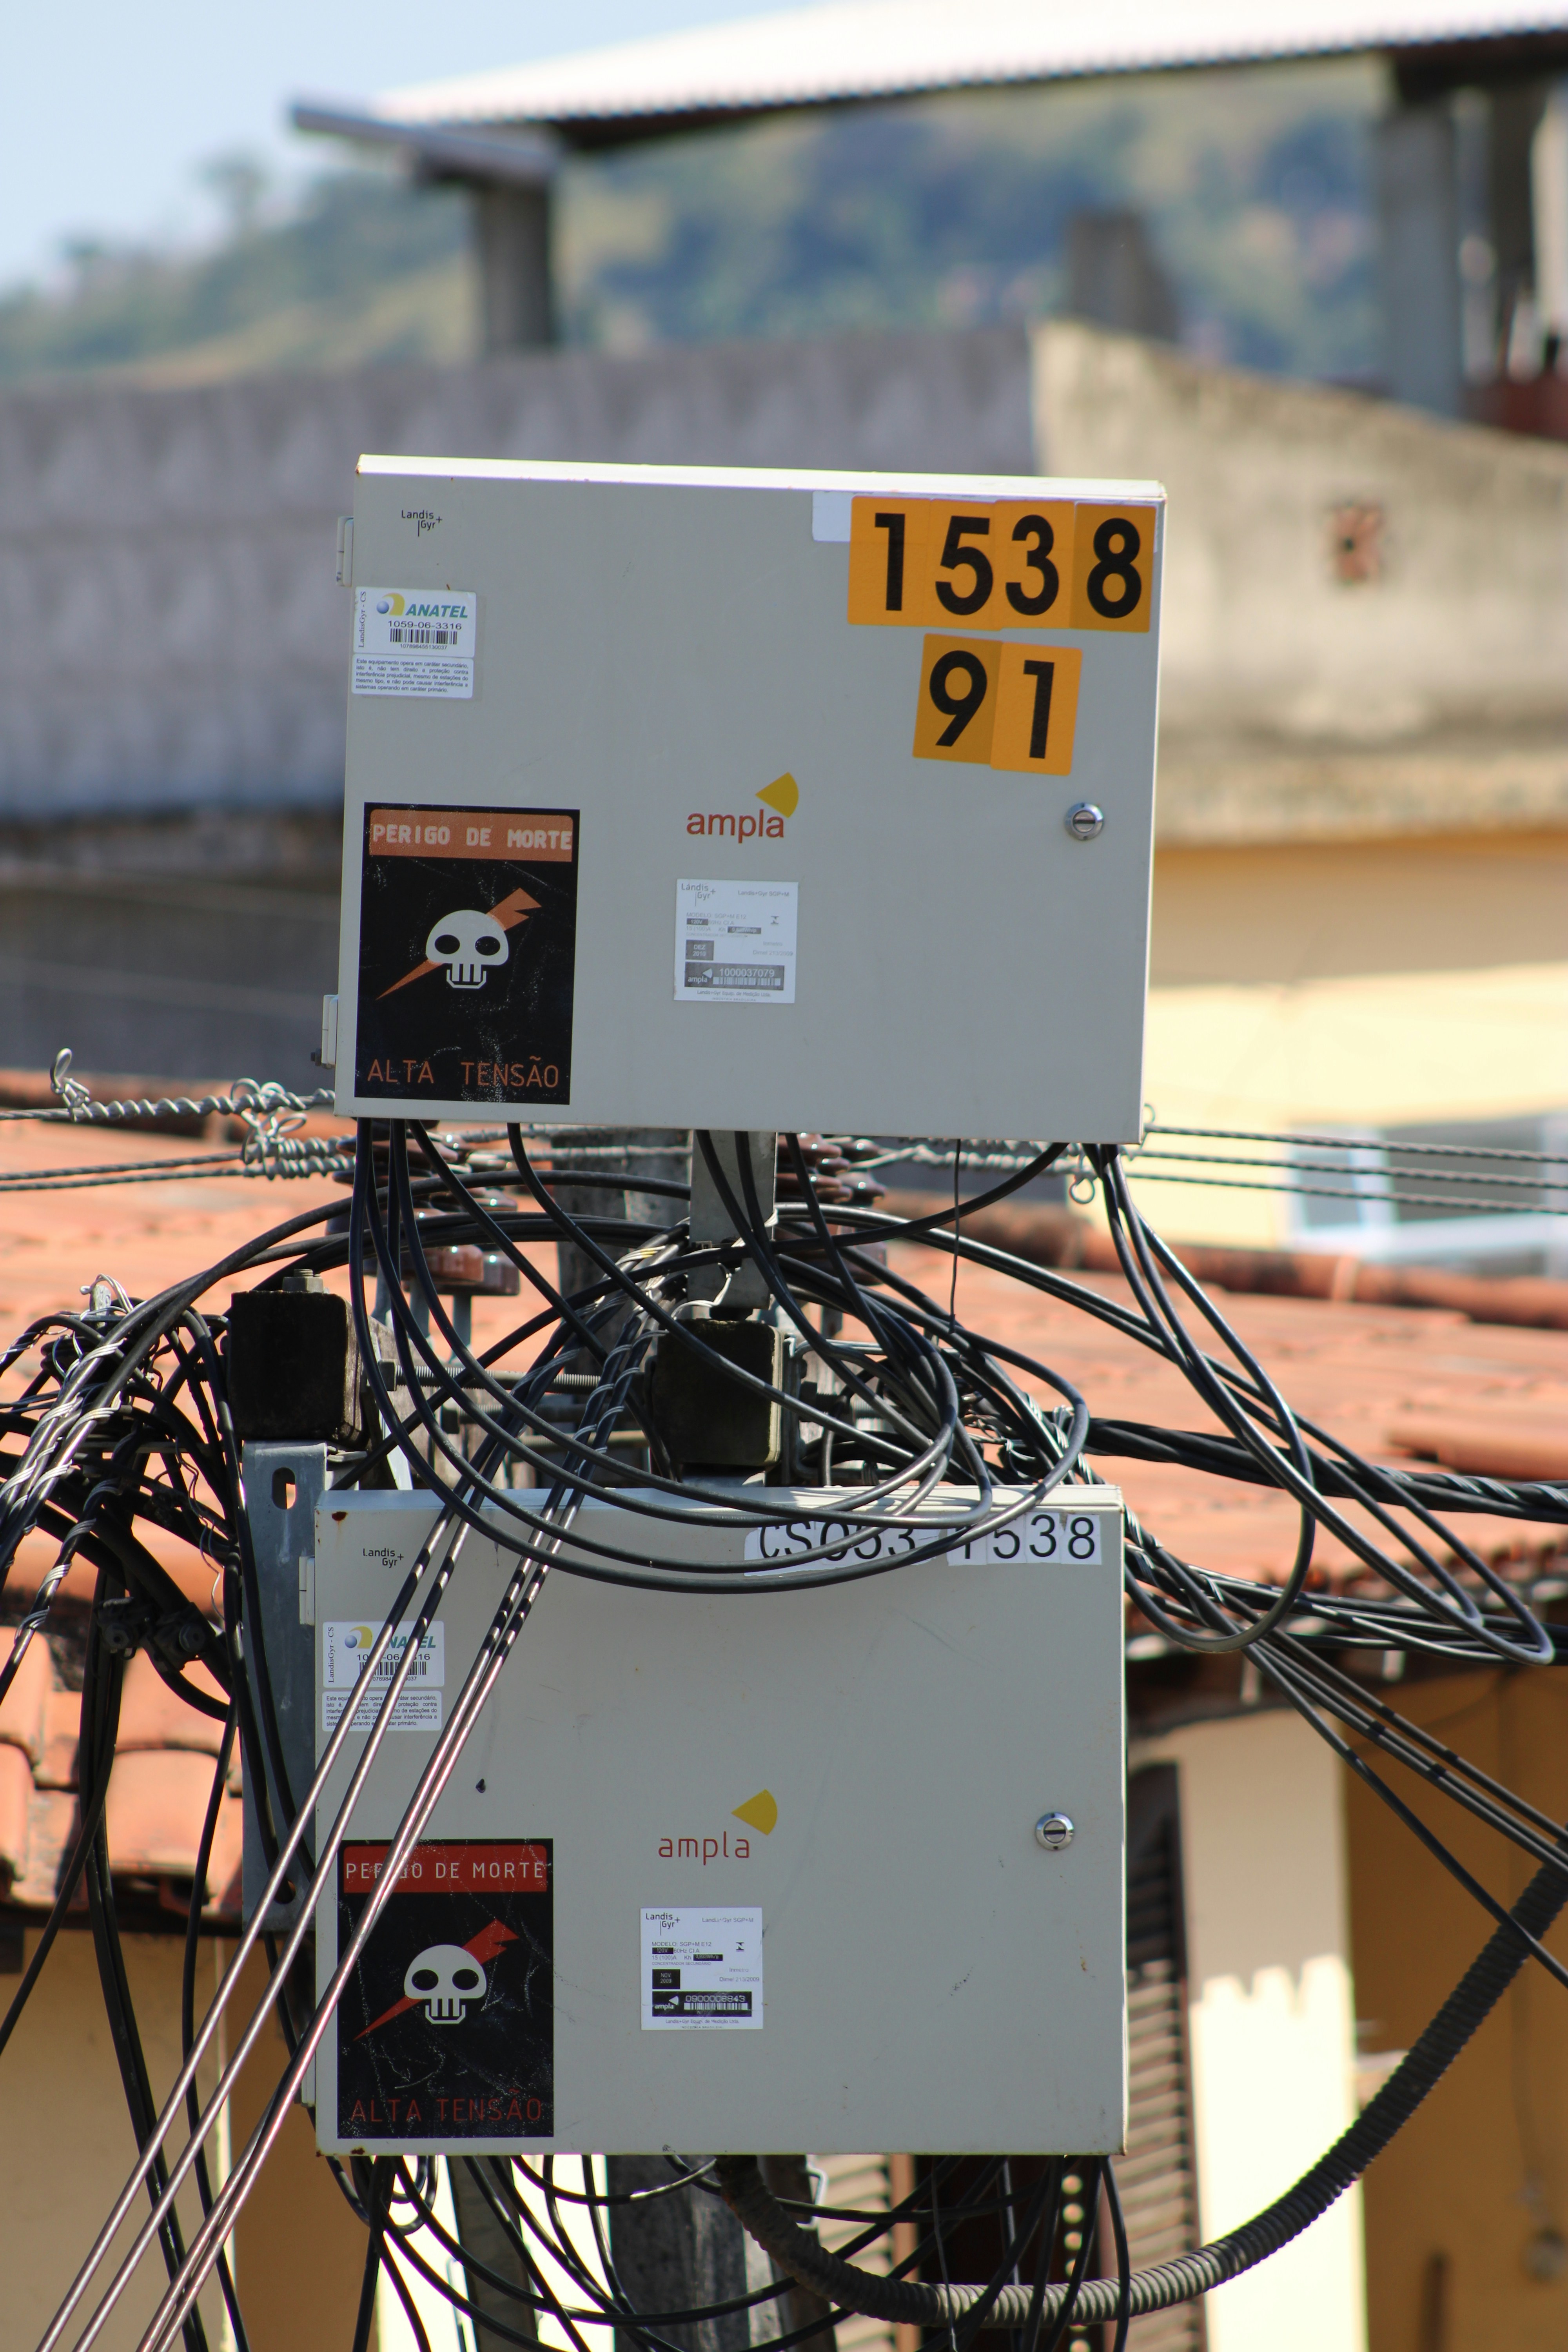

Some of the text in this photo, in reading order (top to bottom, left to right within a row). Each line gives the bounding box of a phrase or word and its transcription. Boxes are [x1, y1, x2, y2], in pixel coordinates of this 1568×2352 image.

[401, 510, 434, 519] Landis
[874, 513, 1142, 619] 1538
[360, 591, 366, 602] CS
[405, 604, 468, 618] ANATEL
[388, 621, 462, 630] 1059-06-3316
[929, 650, 1054, 759] 91
[686, 809, 784, 844] ampla
[373, 824, 572, 850] PERIGO DE MORTE
[681, 883, 709, 891] Landis
[720, 968, 775, 977] 1000037079
[688, 976, 707, 984] ampla
[368, 1055, 559, 1088] ALTA TENSÃO
[363, 1548, 395, 1557] Landis
[328, 1627, 334, 1637] CS
[388, 1636, 436, 1648] NAEL
[659, 1831, 749, 1865] ampla
[436, 1863, 459, 1878] DE
[473, 1862, 543, 1878] MORTE
[352, 2089, 541, 2122] ALTA TENSÃO
